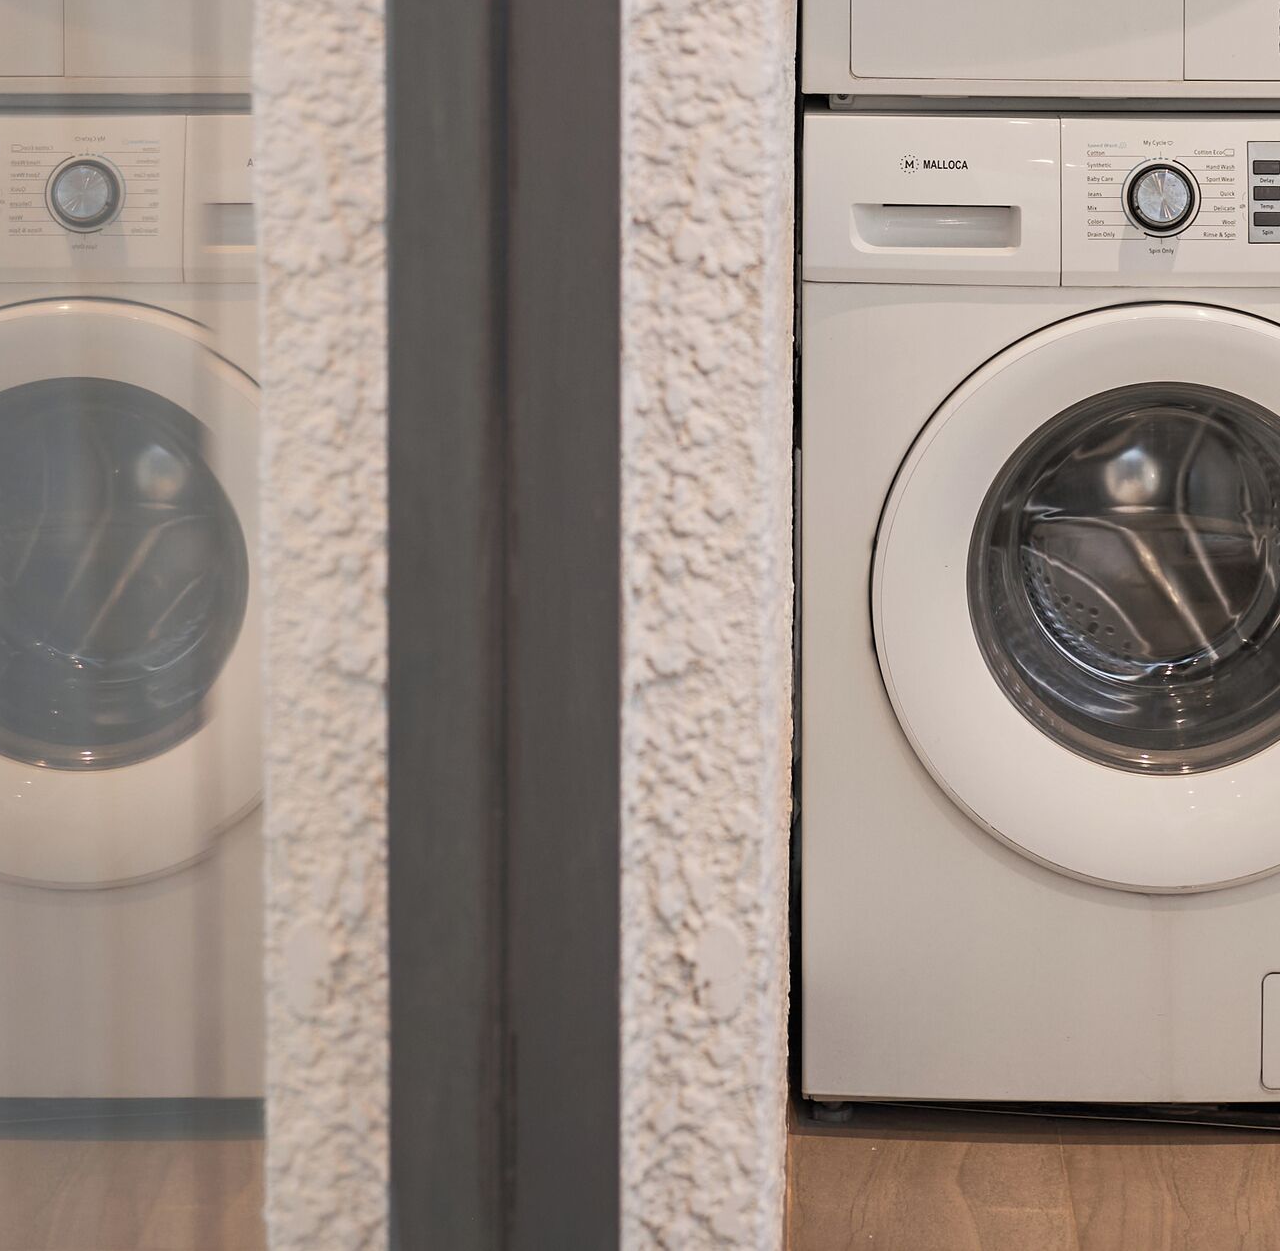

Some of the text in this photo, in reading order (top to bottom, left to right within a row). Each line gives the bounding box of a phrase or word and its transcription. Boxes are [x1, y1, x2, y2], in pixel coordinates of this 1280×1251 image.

[922, 159, 969, 170] MALLOCA
[1086, 161, 1112, 169] Synthetic
[1102, 231, 1116, 239] Only
[1148, 247, 1174, 255] Spin Only
